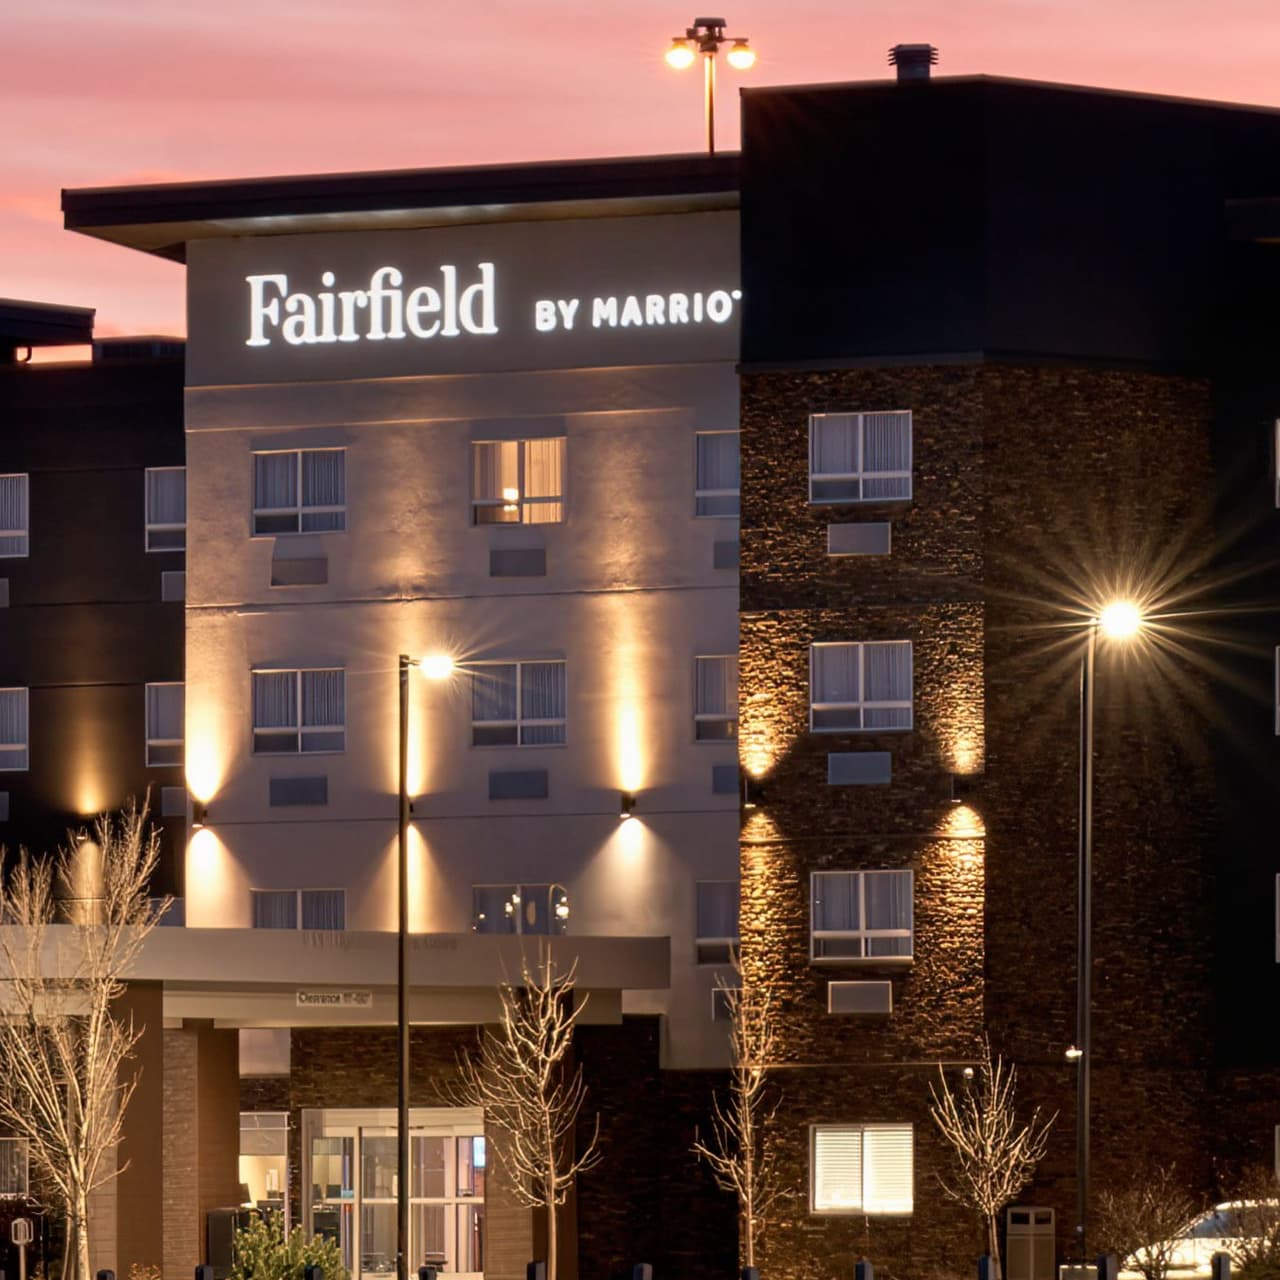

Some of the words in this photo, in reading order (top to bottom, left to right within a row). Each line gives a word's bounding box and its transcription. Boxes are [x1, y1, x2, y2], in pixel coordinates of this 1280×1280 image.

[245, 262, 500, 348] Fairfield
[534, 298, 580, 333] BY
[591, 289, 743, 328] MARRIO
